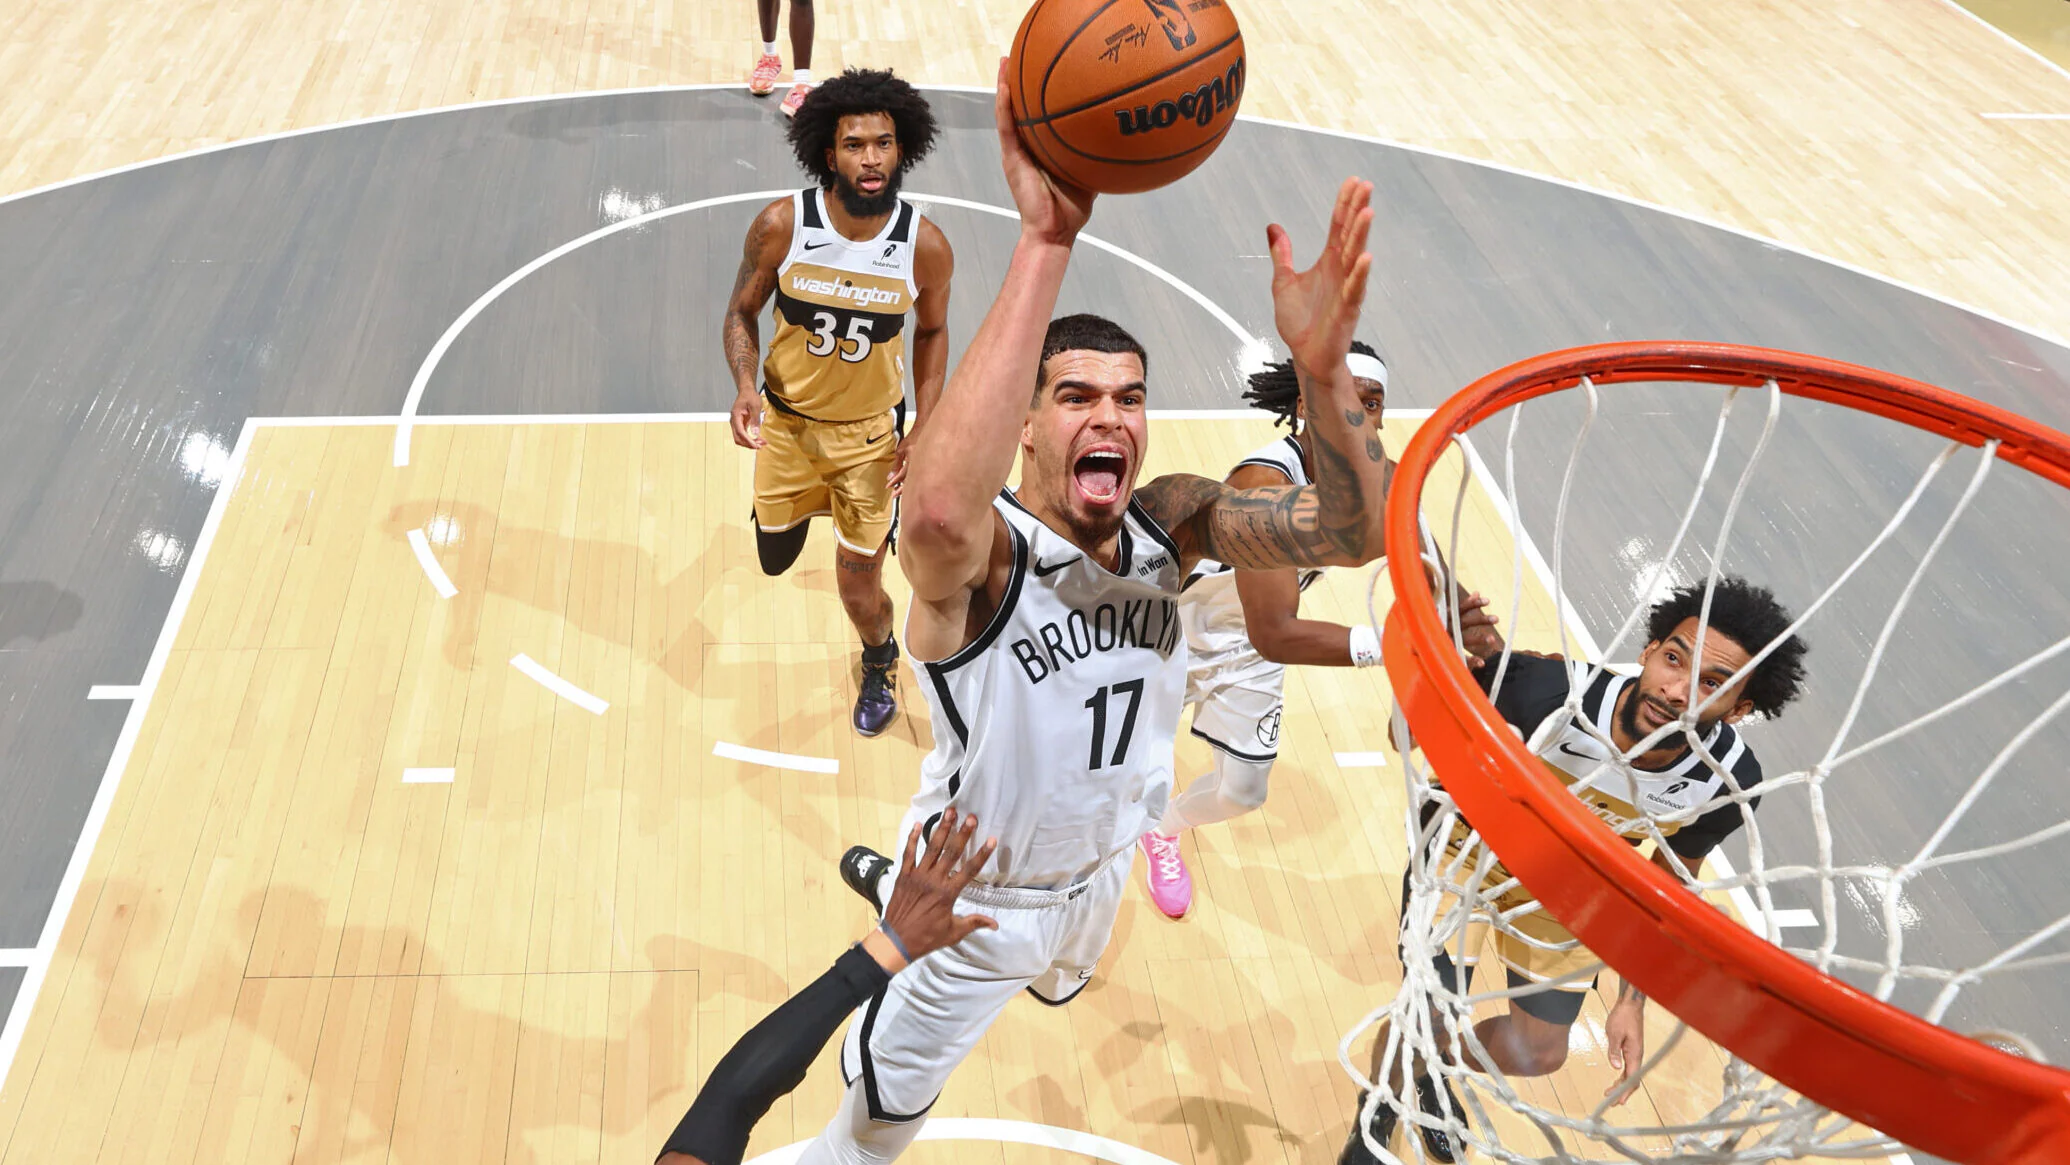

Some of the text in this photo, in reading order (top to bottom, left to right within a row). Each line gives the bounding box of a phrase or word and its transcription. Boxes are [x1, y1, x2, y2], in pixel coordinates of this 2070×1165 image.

[1115, 56, 1245, 136] Wilson
[871, 259, 900, 270] Robinhood
[792, 276, 901, 306] washington
[807, 311, 874, 362] 35
[1144, 556, 1169, 572] Won
[1010, 597, 1178, 684] BROOKLYN
[1084, 678, 1145, 770] 17
